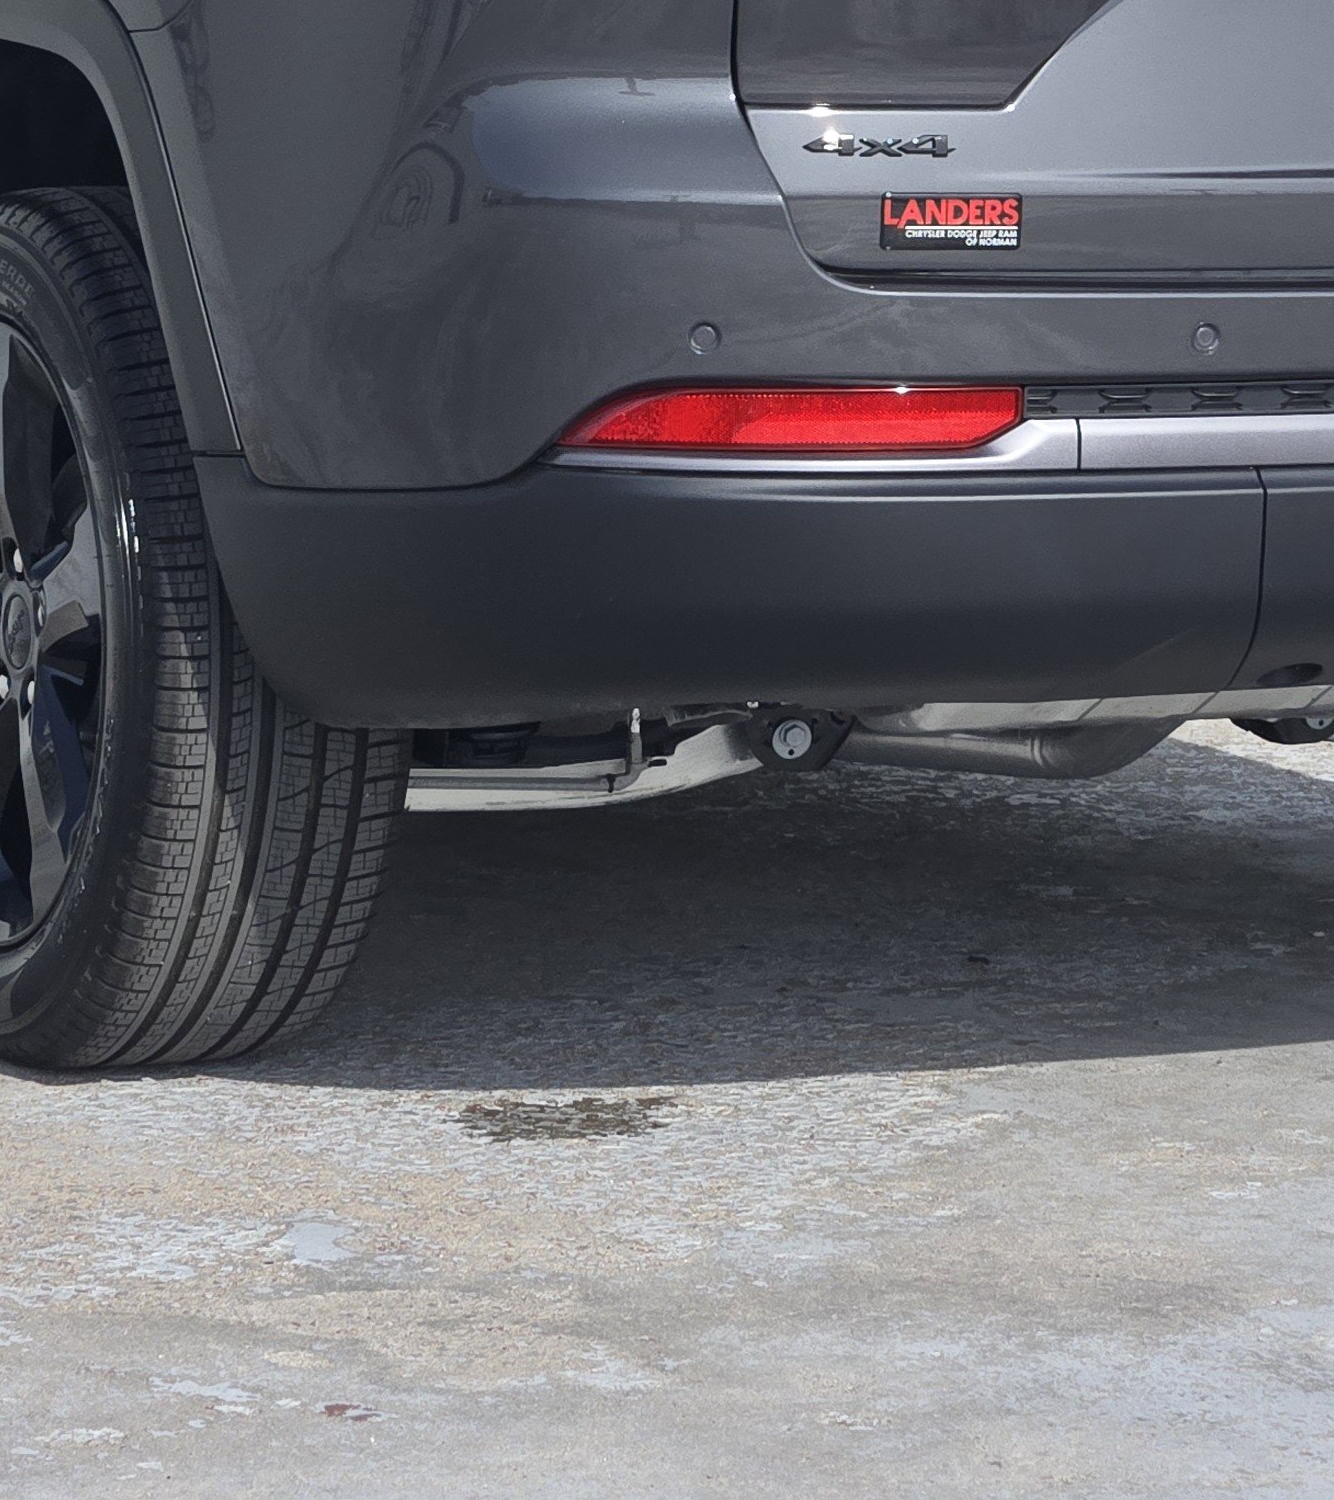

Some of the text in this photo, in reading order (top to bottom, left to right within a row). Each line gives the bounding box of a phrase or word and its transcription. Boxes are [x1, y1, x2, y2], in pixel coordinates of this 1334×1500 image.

[801, 133, 957, 158] 4x4
[883, 198, 1020, 229] LANDERS
[904, 229, 1018, 238] CHRYSLER DODGE JEEP RAM
